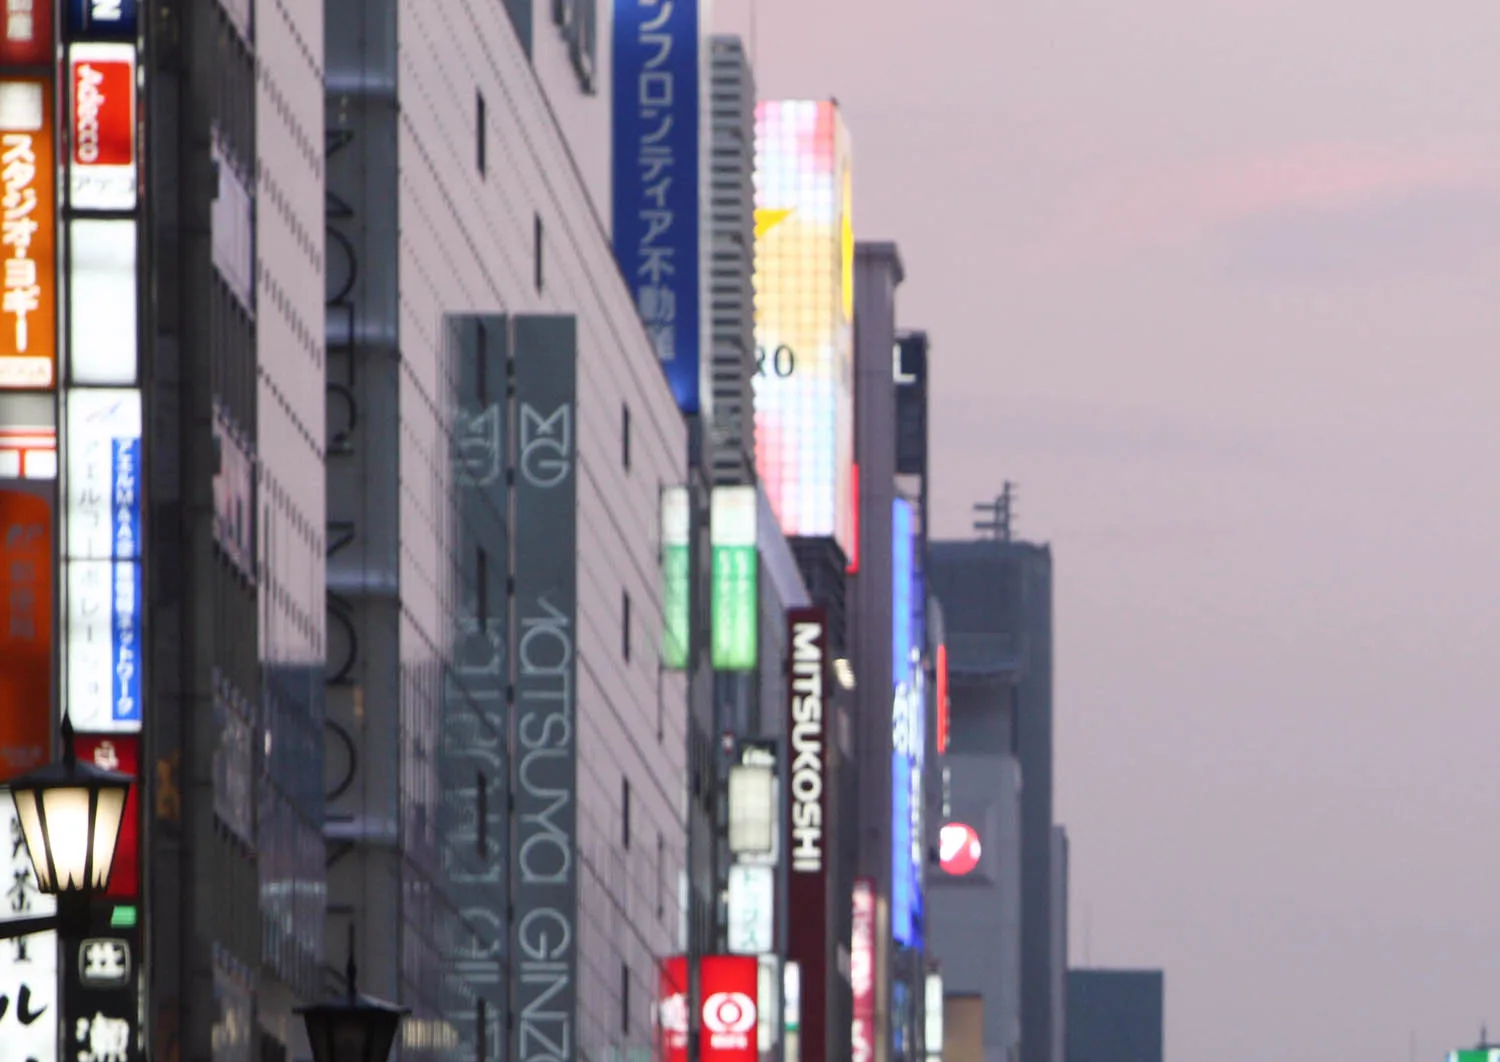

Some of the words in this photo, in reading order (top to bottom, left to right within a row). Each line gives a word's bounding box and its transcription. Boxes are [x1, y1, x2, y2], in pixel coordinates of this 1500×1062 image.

[2, 134, 40, 352] スタジオ・ヨギー
[792, 622, 822, 872] MITSUKOSHI
